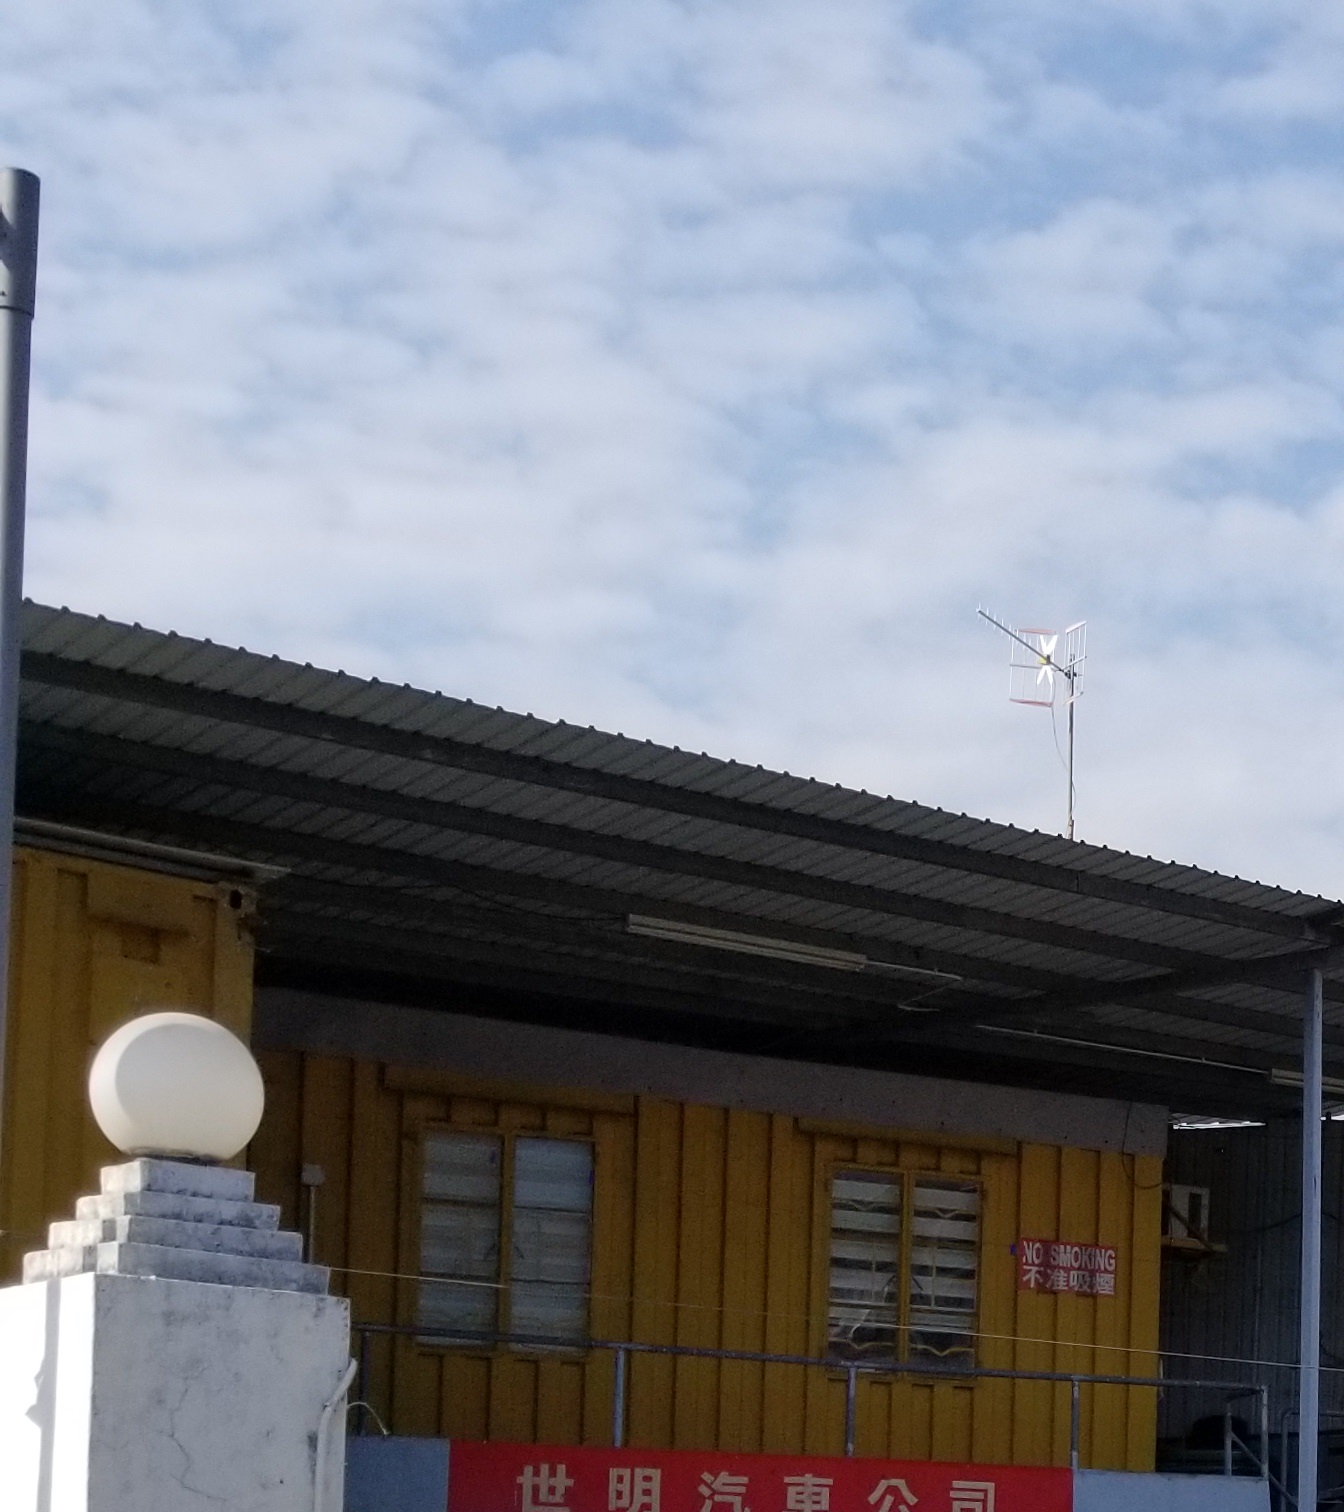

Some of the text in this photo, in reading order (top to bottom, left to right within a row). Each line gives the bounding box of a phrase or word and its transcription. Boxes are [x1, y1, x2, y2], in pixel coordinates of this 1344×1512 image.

[1023, 1241, 1116, 1271] NO SMOKING
[1023, 1265, 1115, 1295] 不准吸煙
